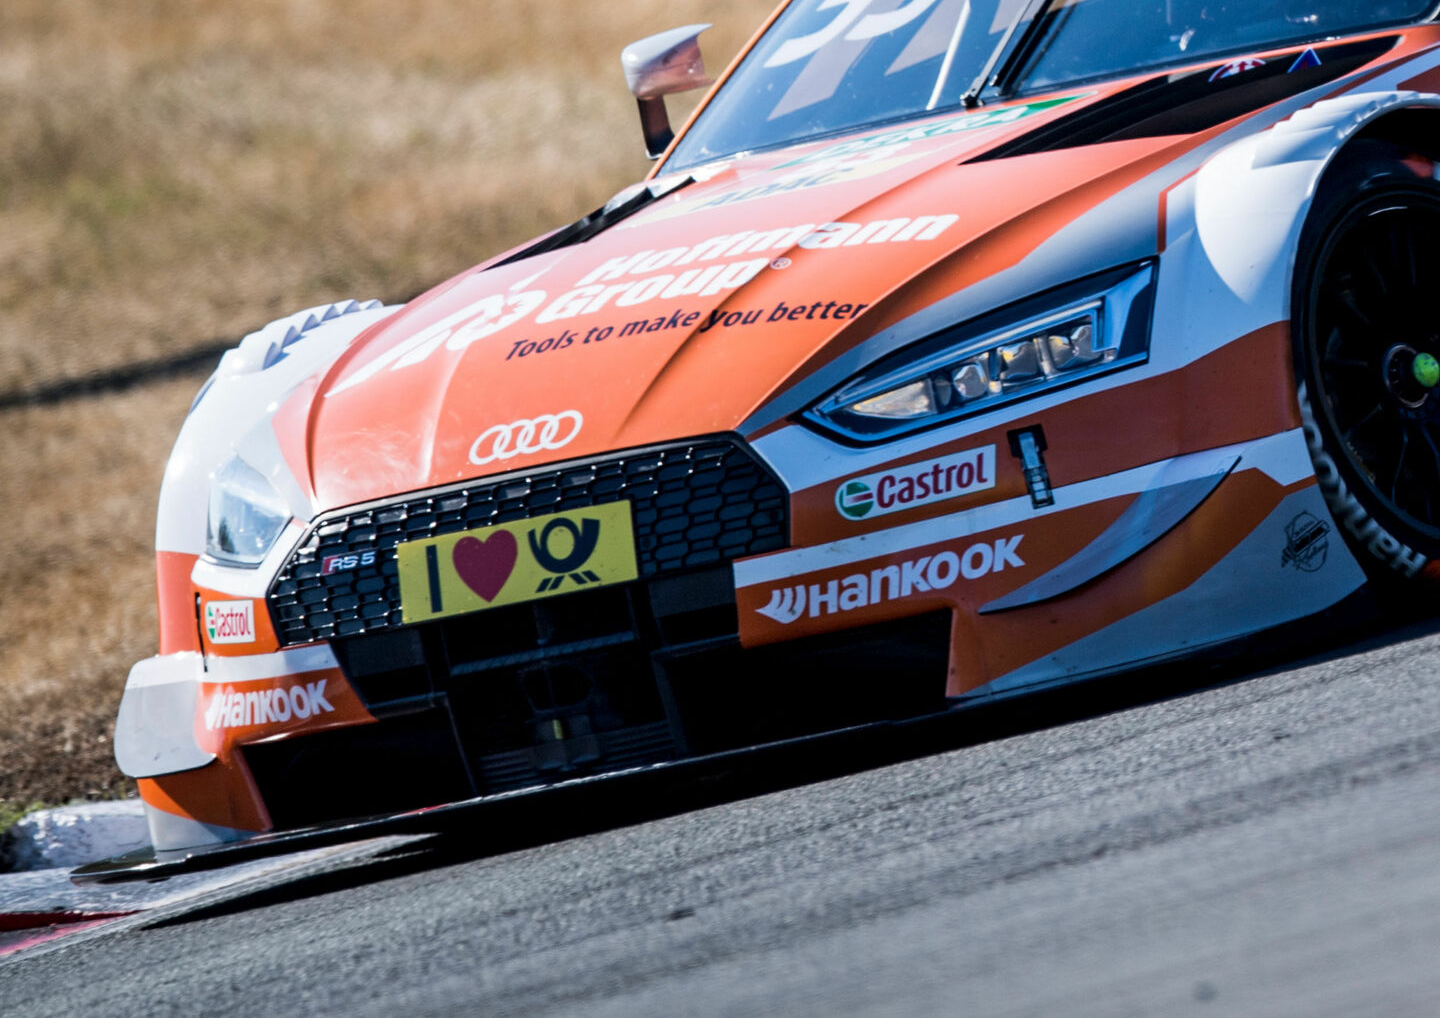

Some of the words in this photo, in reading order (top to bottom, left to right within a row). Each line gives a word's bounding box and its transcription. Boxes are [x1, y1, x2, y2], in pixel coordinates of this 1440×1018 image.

[574, 213, 960, 286] Hoffmann
[505, 329, 575, 360] Tools
[584, 325, 614, 344] to
[617, 307, 699, 339] make
[699, 307, 760, 333] you
[766, 300, 869, 323] better
[876, 452, 988, 509] Castrol
[328, 555, 358, 572] RS
[360, 551, 376, 566] 5
[425, 544, 443, 613] I
[214, 606, 252, 638] Castrol
